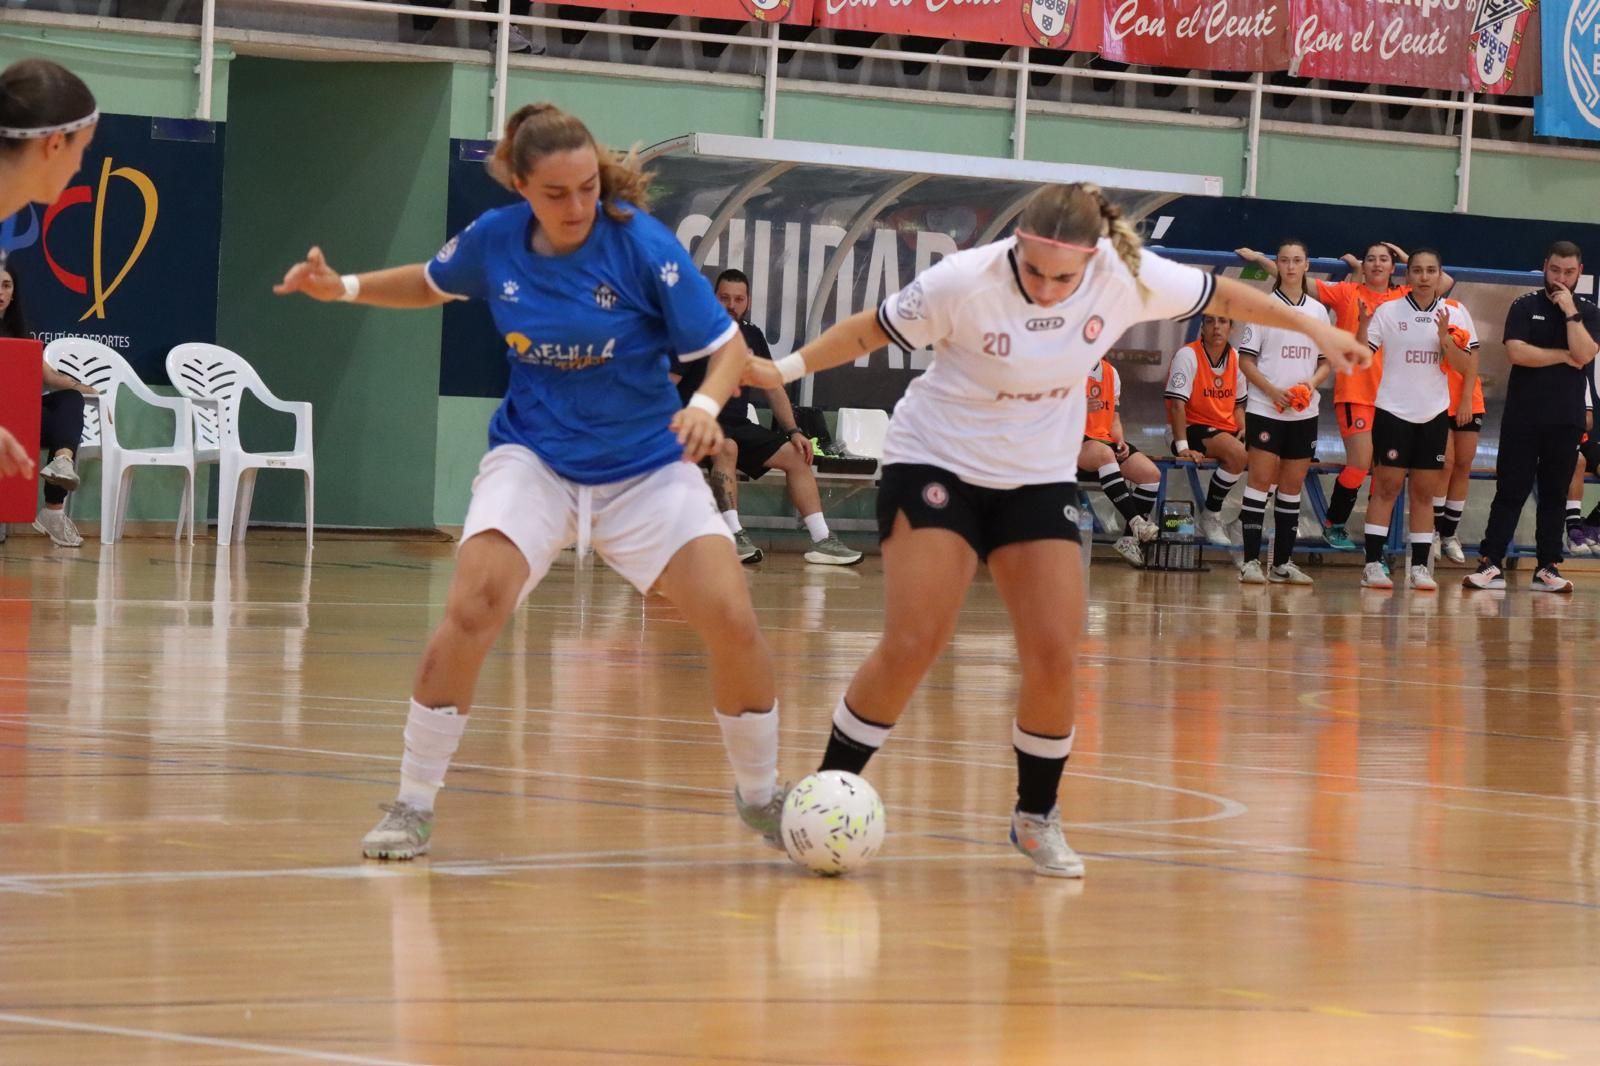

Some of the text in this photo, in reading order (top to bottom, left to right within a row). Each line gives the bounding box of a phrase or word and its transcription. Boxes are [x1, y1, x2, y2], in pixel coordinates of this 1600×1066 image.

[1110, 0, 1277, 44] Con el Ceutí
[1294, 14, 1450, 60] Con el Ceutí
[983, 332, 1011, 357] 20
